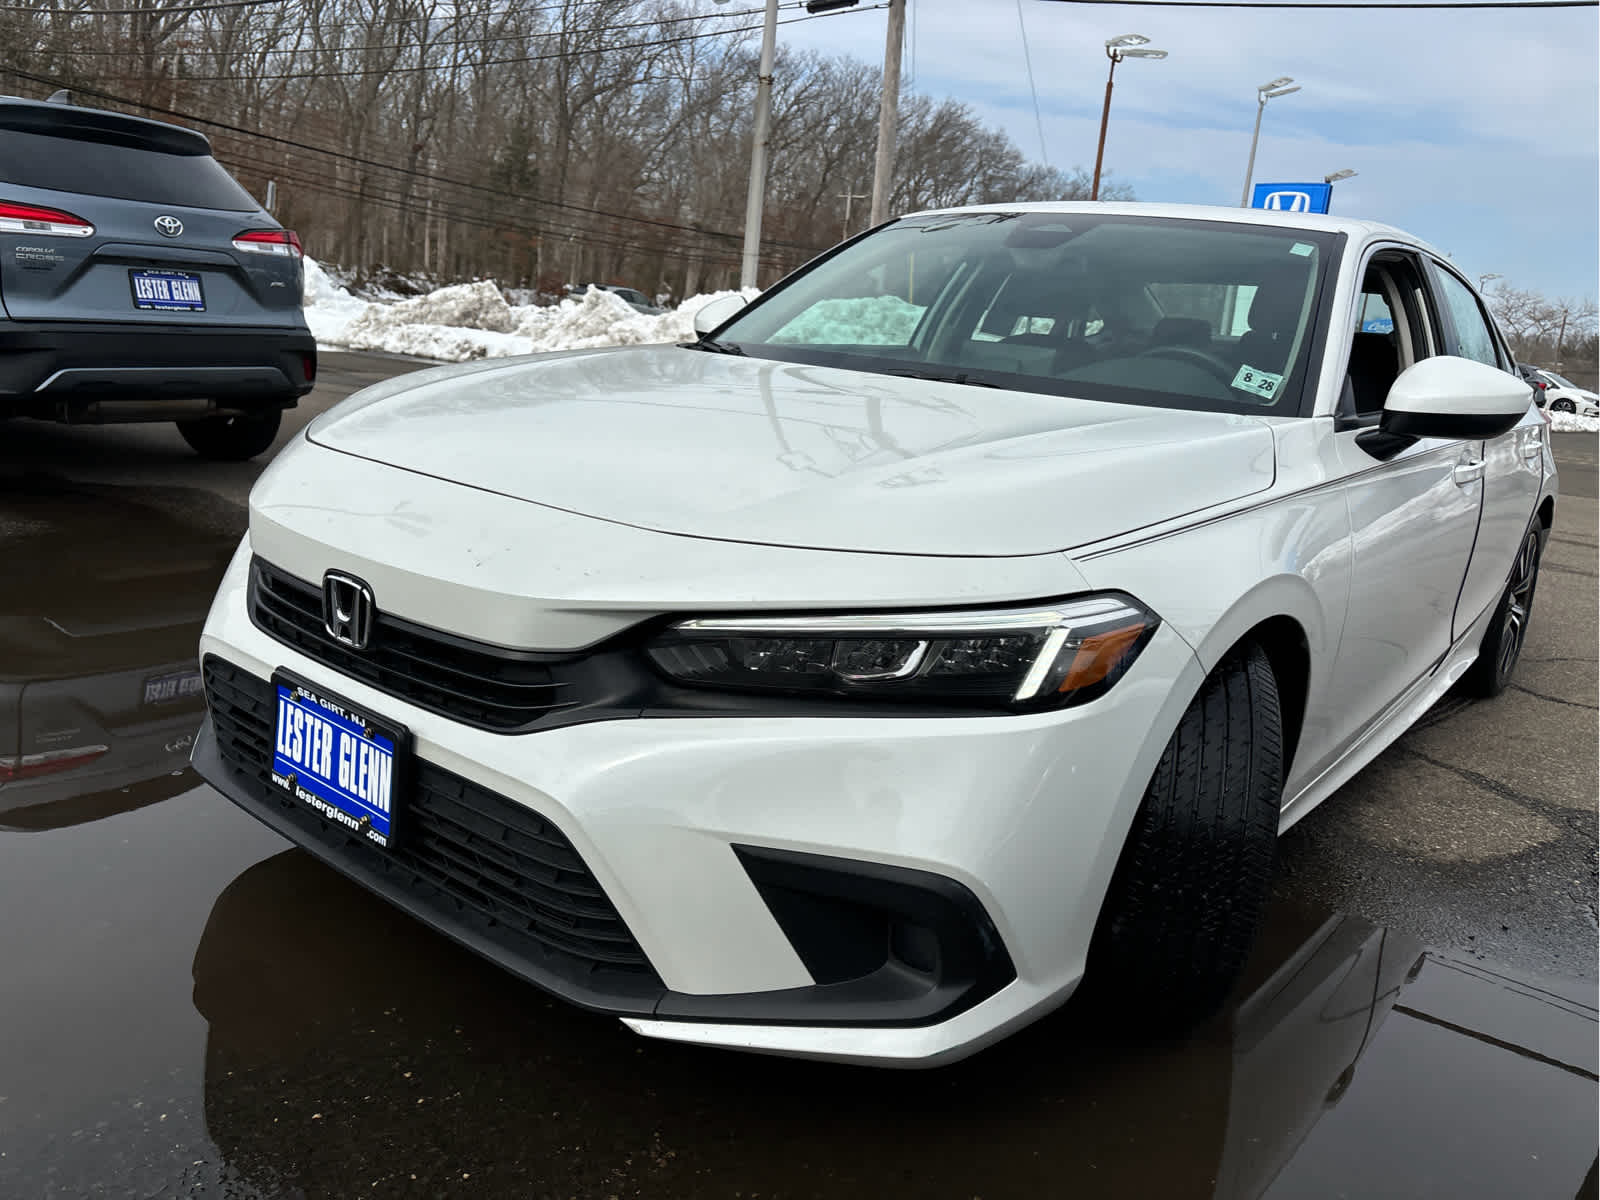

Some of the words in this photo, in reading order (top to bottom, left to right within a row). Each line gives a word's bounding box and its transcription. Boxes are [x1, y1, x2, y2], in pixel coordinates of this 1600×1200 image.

[134, 277, 170, 300] LESTER
[171, 280, 201, 302] GLENN
[1244, 373, 1253, 382] 8
[1258, 379, 1274, 391] 28
[297, 686, 318, 705] SEA
[319, 697, 349, 721] GIRT,
[350, 712, 366, 727] NJ
[277, 700, 333, 780] LESTER
[339, 732, 392, 813] GLENN
[296, 786, 359, 831] lesterglenn
